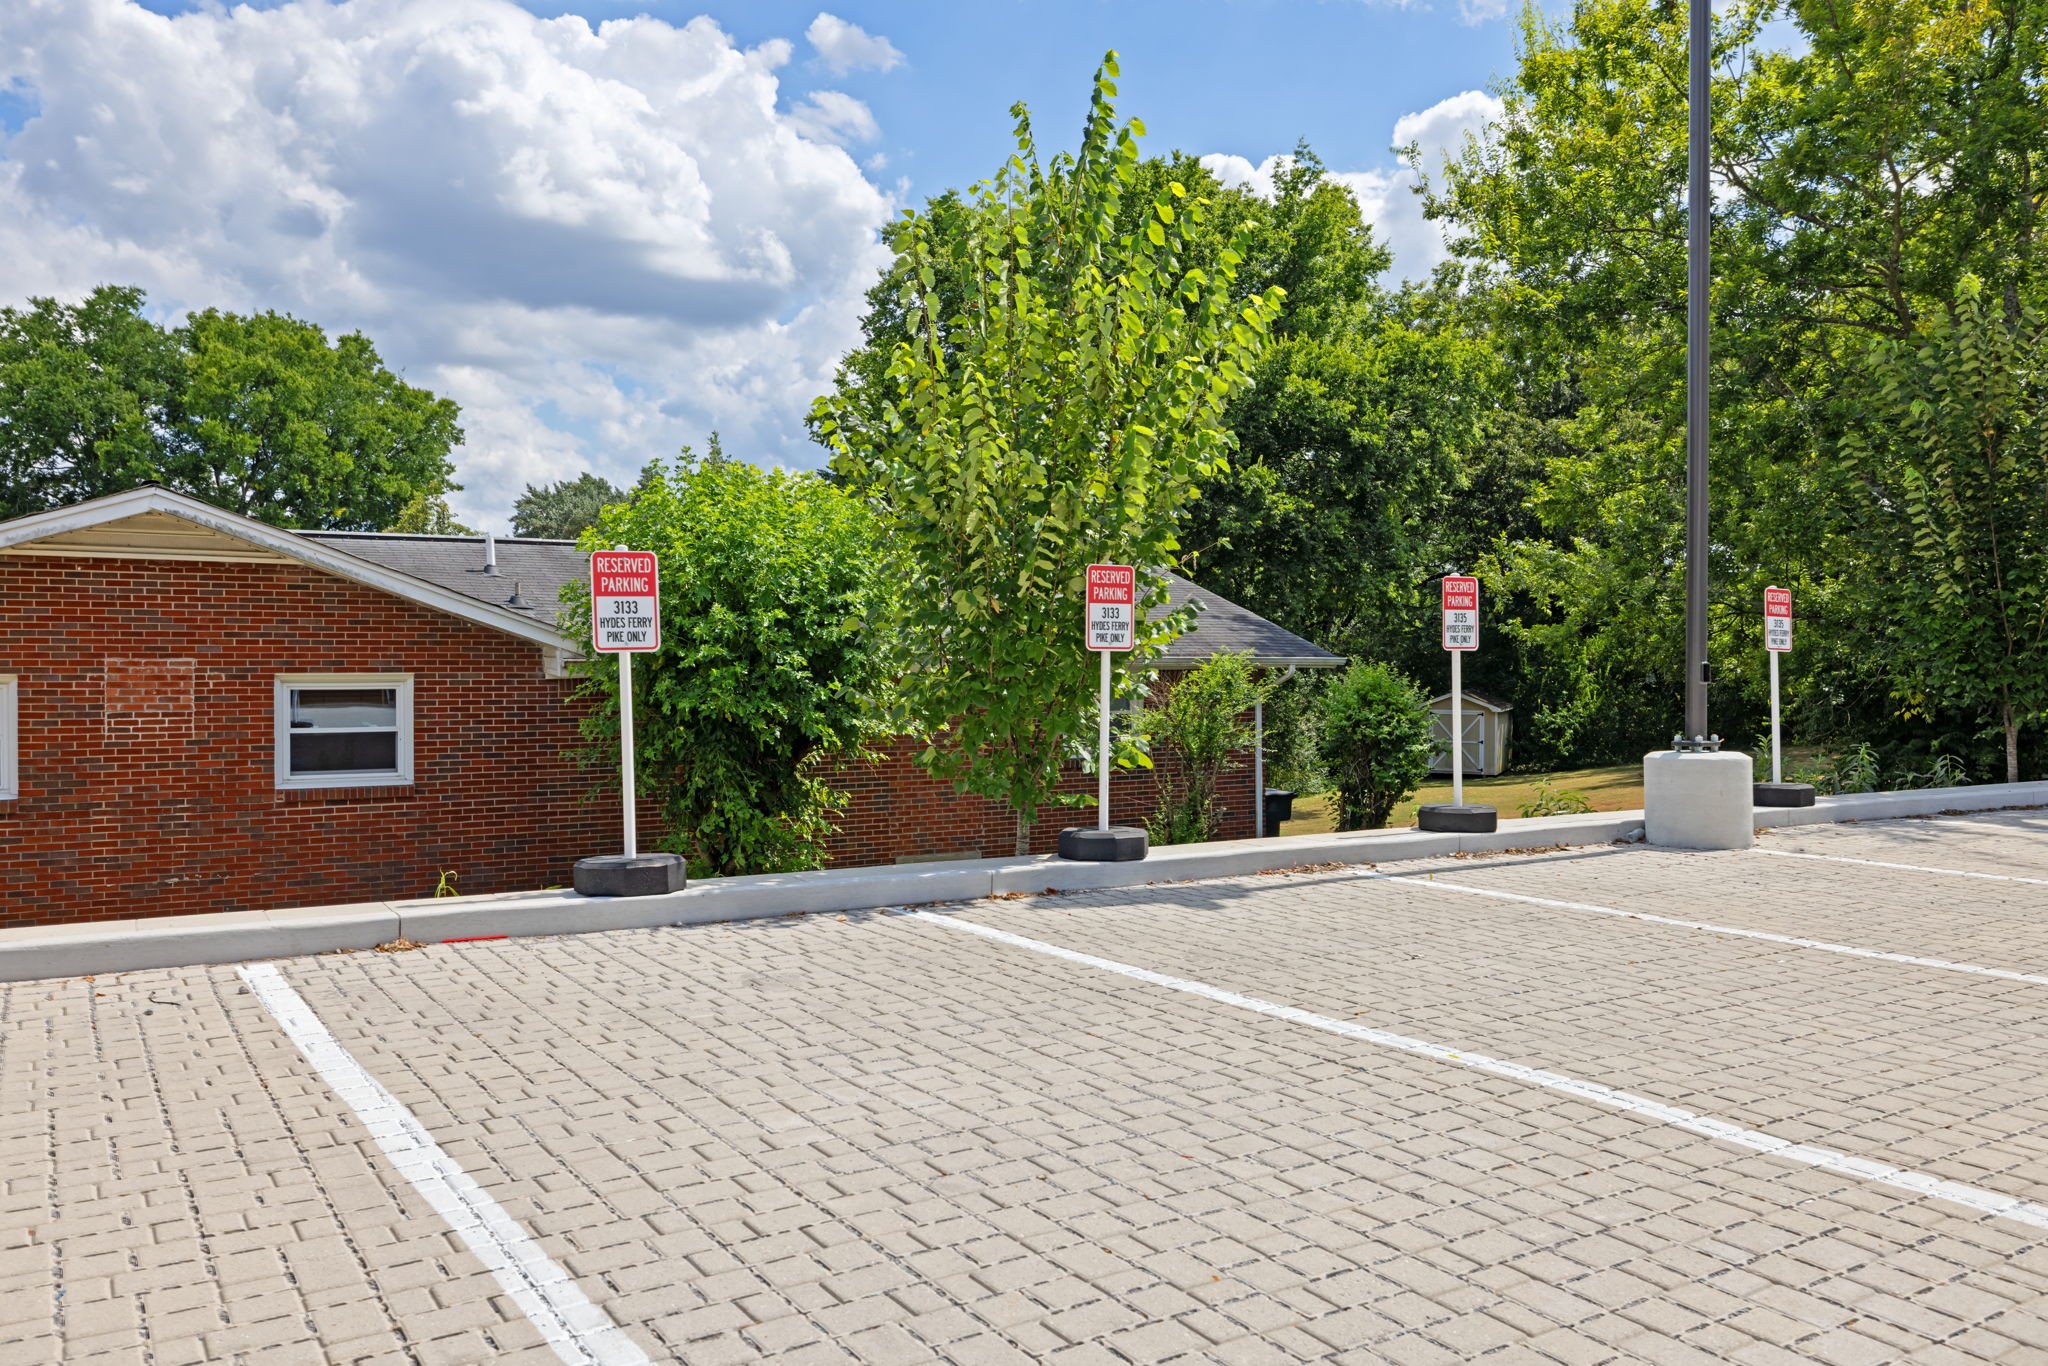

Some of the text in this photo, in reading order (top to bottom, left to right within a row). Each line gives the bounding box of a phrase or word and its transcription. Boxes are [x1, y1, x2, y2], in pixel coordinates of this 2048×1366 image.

[597, 557, 651, 573] RESERVED
[1091, 570, 1130, 584] RESERVED
[601, 577, 649, 592] PARKING
[1445, 581, 1474, 593] RESERVED
[1093, 587, 1128, 600] PARKING
[1767, 591, 1790, 603] RESERVED
[614, 600, 638, 614] 3133
[1447, 595, 1473, 607] PARKING
[1101, 607, 1120, 619] 3133
[1769, 604, 1788, 615] PARKING
[600, 617, 652, 628] HYDES FERRY
[1454, 612, 1467, 623] 3135
[1091, 621, 1129, 631] HYDES FERRY
[1446, 624, 1474, 633] HYDES FERRY
[607, 631, 647, 642] PIKE ONLY
[1095, 633, 1125, 643] PIKE ONLY
[1449, 635, 1471, 644] PIKE ONLY
